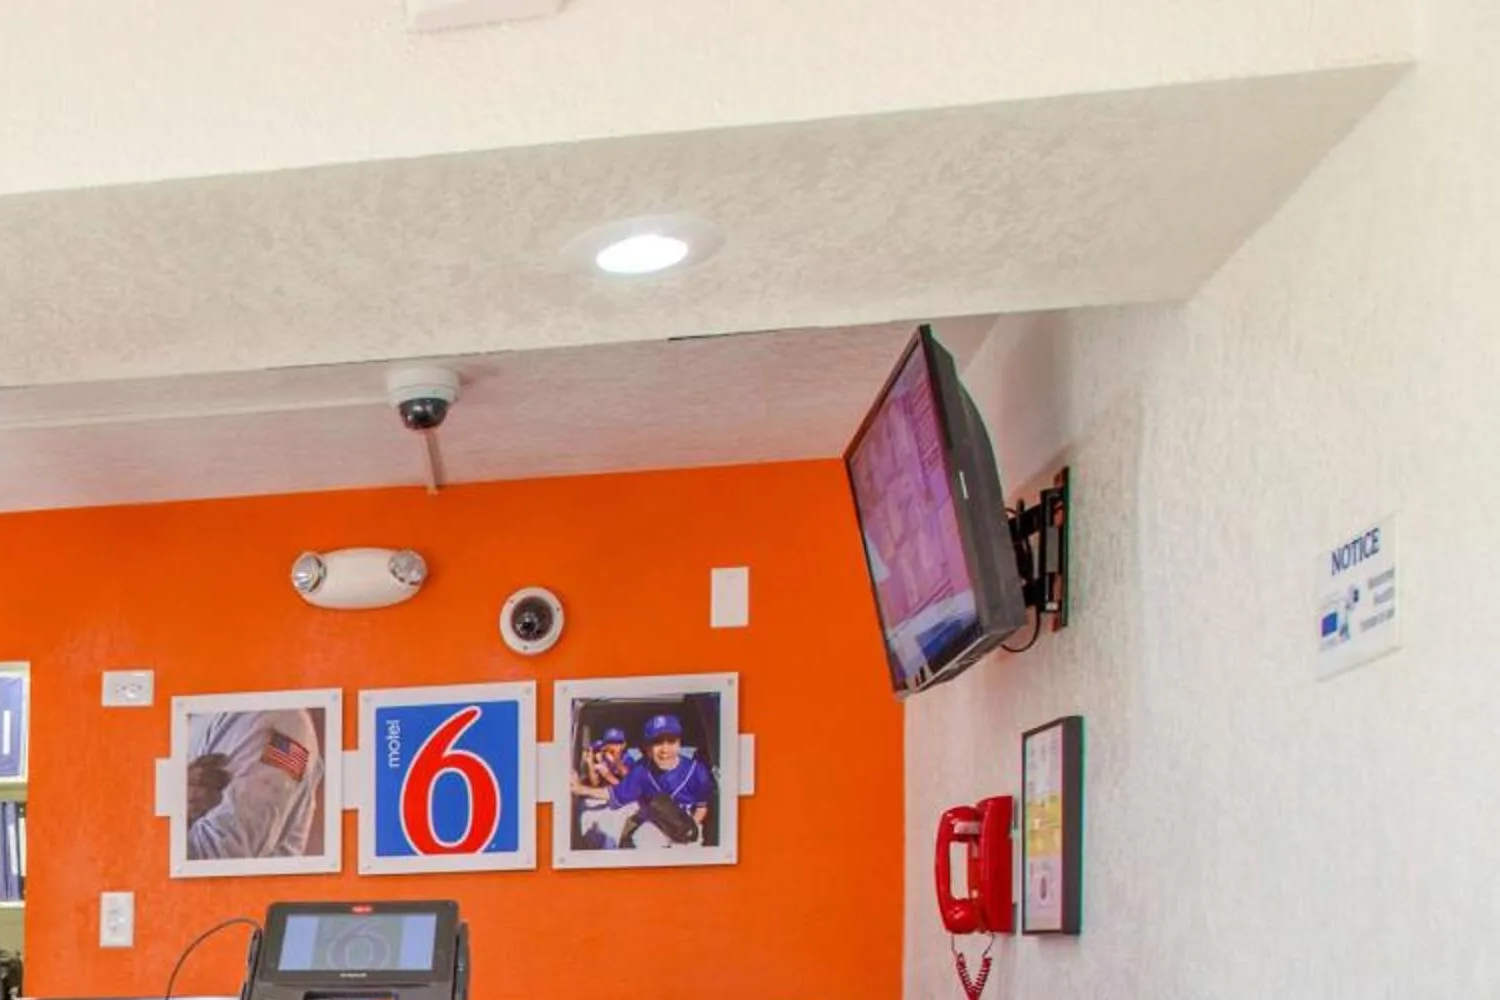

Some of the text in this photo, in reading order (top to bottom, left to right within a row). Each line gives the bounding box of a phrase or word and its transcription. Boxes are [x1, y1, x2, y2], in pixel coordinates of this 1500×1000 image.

[1331, 527, 1380, 576] NOTICE
[385, 705, 502, 857] motel 6
